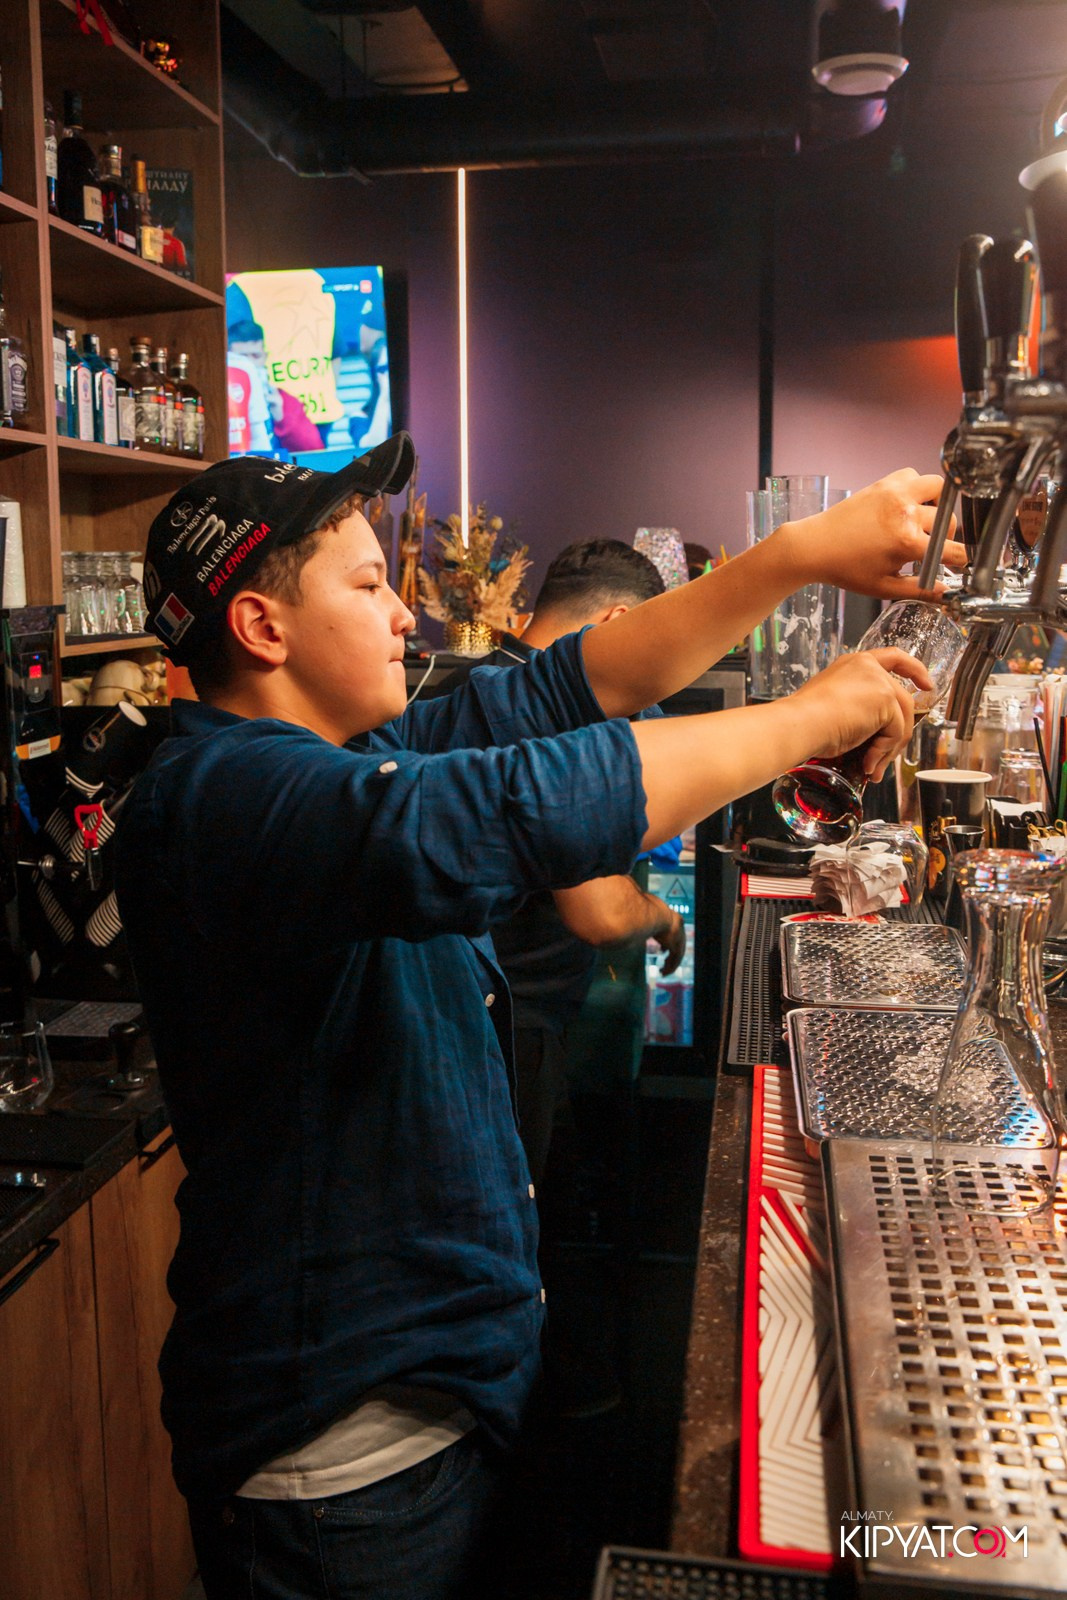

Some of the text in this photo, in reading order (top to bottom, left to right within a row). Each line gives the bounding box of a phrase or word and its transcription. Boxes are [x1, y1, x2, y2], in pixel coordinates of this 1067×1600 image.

[199, 496, 217, 516] Paris
[196, 518, 255, 584] BALENCIAGA
[208, 522, 272, 597] BALENCIAGA
